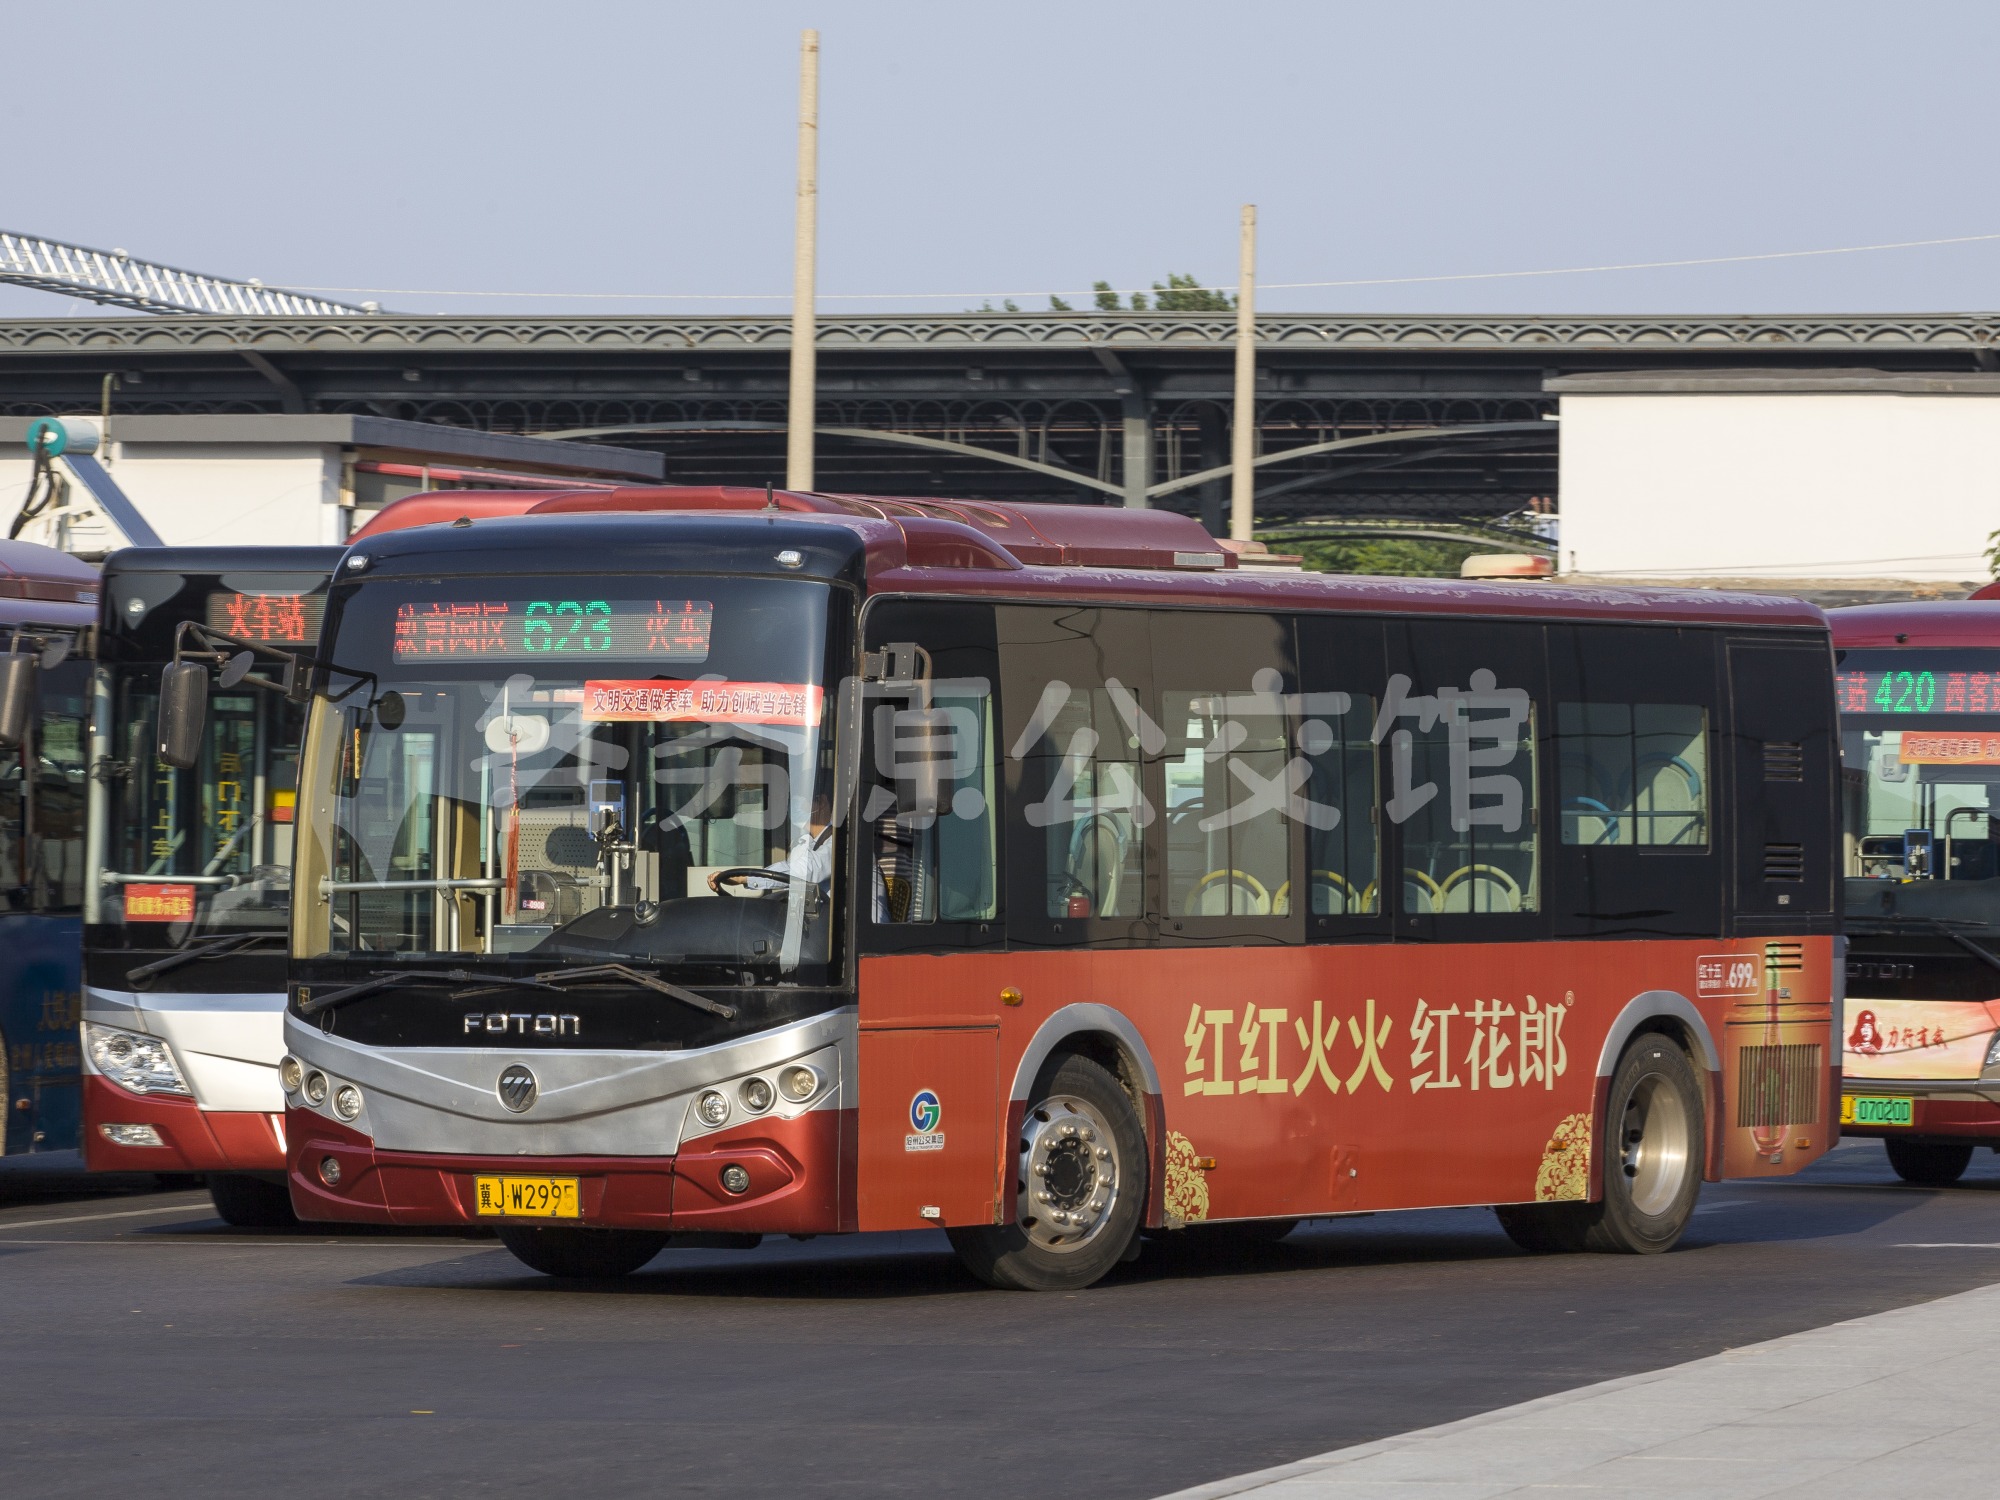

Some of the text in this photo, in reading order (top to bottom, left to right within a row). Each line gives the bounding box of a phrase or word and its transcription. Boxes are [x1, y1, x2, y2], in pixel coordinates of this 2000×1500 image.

[226, 594, 306, 640] 火车站
[523, 600, 612, 652] 623
[647, 600, 713, 652] 火车
[592, 688, 808, 717] 文明交通做表率 助力创城当先锋
[1835, 671, 1868, 712] 站
[1874, 671, 1937, 712] 420
[1728, 962, 1754, 989] 699
[1845, 962, 1914, 979] OTON
[464, 1012, 580, 1036] FOTON
[1183, 993, 1568, 1097] 红红火火 红花郎
